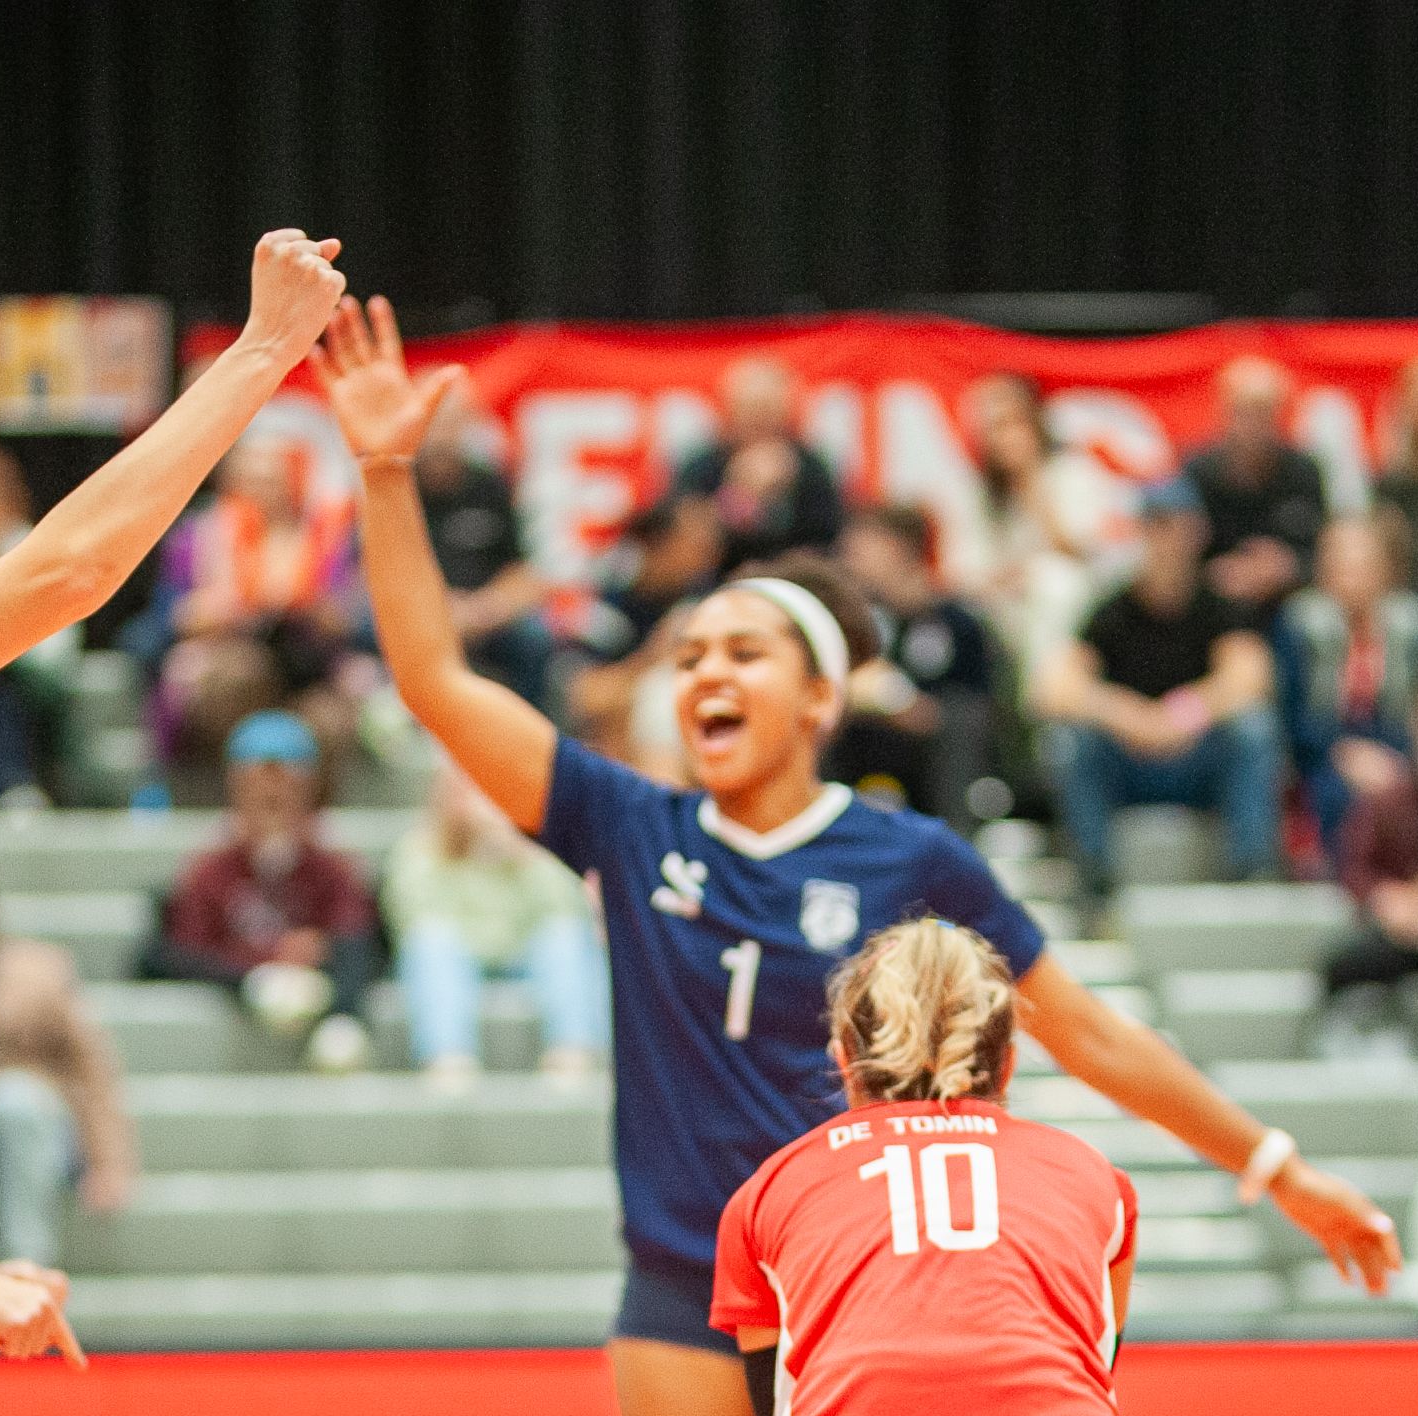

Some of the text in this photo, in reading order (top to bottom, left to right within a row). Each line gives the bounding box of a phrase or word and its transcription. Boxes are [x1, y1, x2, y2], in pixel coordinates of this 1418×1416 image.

[720, 939, 763, 1041] 1
[827, 1115, 998, 1151] DE TOMIN
[858, 1142, 1000, 1256] 10
